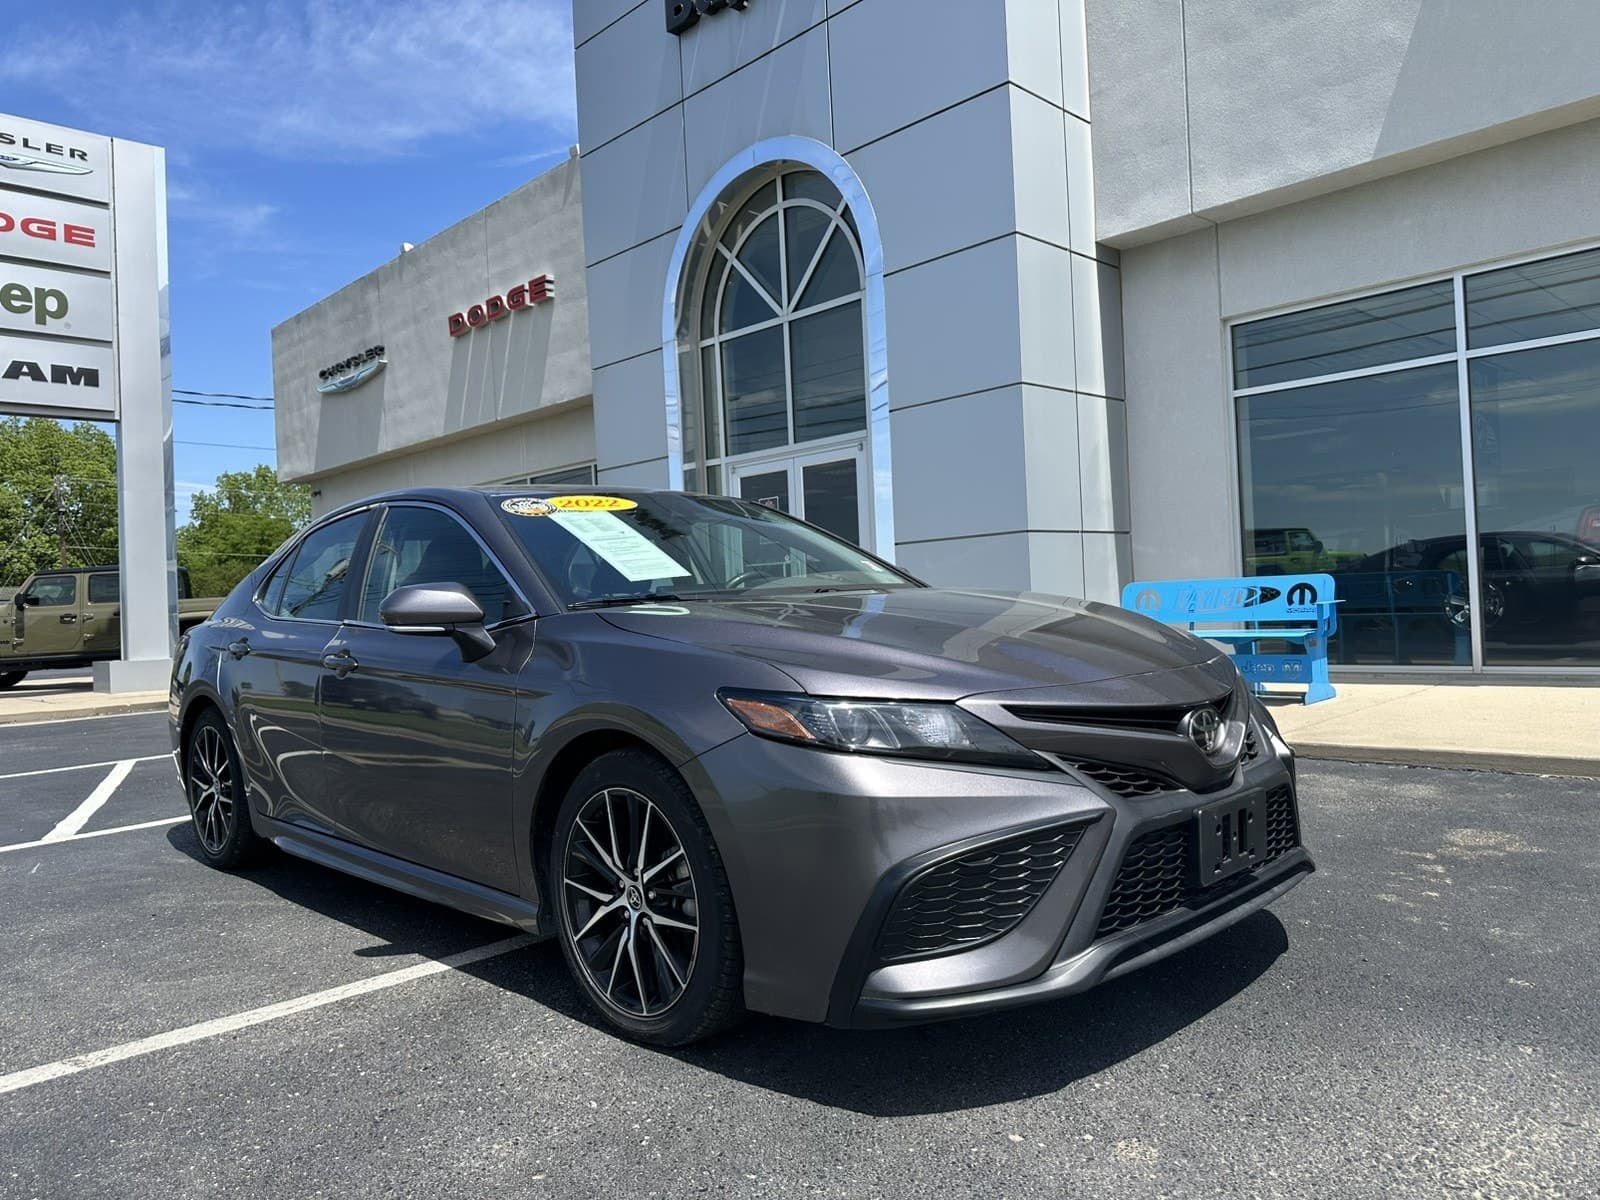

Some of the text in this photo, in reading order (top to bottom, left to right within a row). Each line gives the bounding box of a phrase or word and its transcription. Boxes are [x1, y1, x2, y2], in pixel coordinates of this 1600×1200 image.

[0, 282, 69, 326] ep
[448, 273, 554, 338] DODGE
[1, 360, 100, 388] AM
[559, 500, 619, 508] 2022
